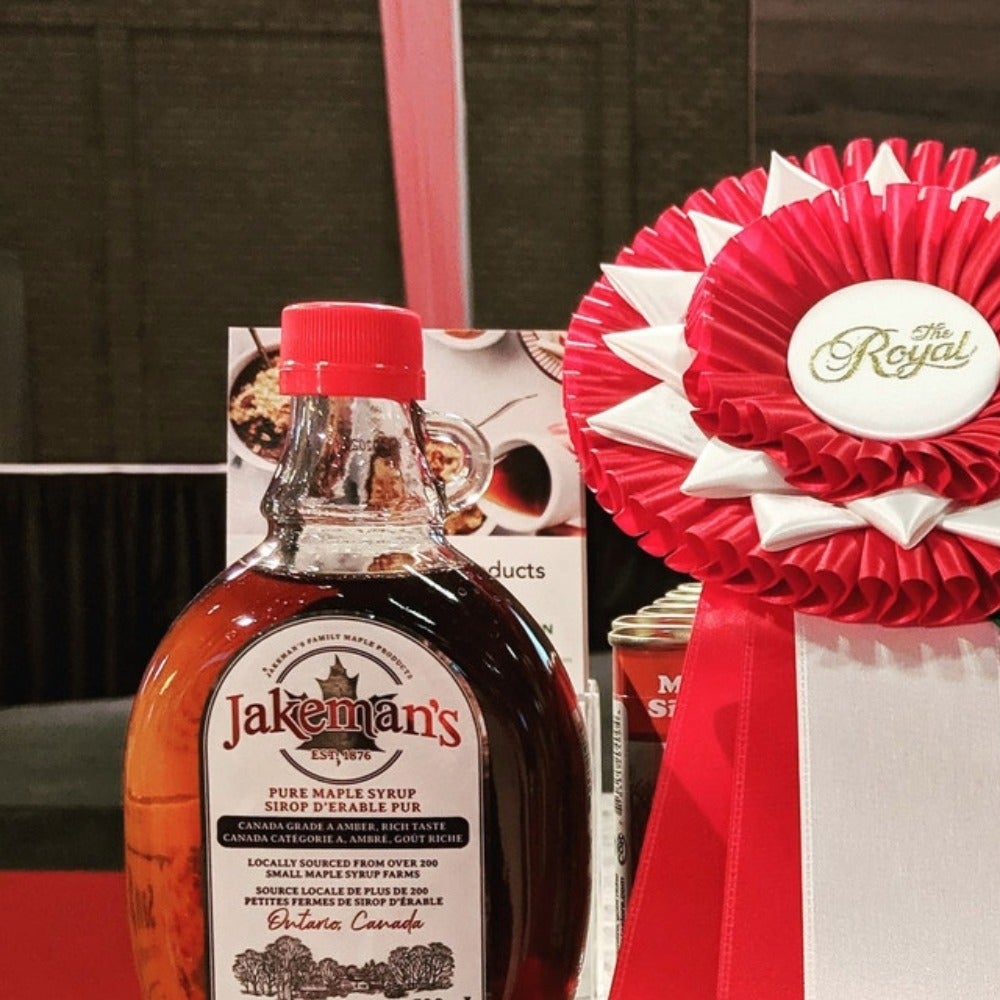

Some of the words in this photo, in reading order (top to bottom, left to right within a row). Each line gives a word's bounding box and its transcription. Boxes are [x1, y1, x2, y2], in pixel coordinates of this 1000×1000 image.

[911, 323, 953, 341] The
[810, 325, 978, 383] Royal
[488, 559, 546, 579] ducts
[343, 633, 376, 648] MAPLE
[375, 643, 414, 680] PRODUCTS
[222, 686, 462, 751] Jakeman's
[344, 749, 372, 761] 1876
[269, 787, 309, 799] PURE
[312, 788, 364, 799] MAPLE
[367, 788, 417, 800] SYRUP
[264, 801, 309, 812] SIROP
[313, 801, 387, 813] D'ERABLE
[391, 802, 422, 813] PUR
[237, 821, 285, 831] CANADA
[286, 822, 324, 832] GRADE
[326, 822, 335, 832] A
[381, 822, 410, 832] RICH
[411, 822, 447, 832] TASTE
[222, 833, 269, 843] CANADA
[428, 834, 464, 844] RICHE
[247, 858, 298, 868] LOCALLY
[299, 859, 351, 868] SOURCED
[353, 859, 386, 868] FROM
[387, 859, 418, 868] OVER
[420, 859, 439, 868] 200
[265, 869, 303, 879] SMALL
[305, 869, 344, 879] MAPLE
[345, 870, 381, 879] SYRUP
[383, 870, 421, 879] FARMS
[255, 886, 300, 895] SOURCE
[301, 887, 345, 896] LOCALE
[346, 887, 362, 896] DE
[363, 887, 391, 896] PLUS
[393, 887, 409, 896] DE
[410, 887, 430, 896] 200
[244, 897, 290, 906] PETITES
[291, 897, 336, 907] FERMES
[337, 898, 352, 907] DE
[354, 897, 387, 907] SIROP
[388, 896, 444, 907] D'ÉRABLE
[267, 908, 342, 931] Ontario,
[350, 909, 425, 934] Canada
